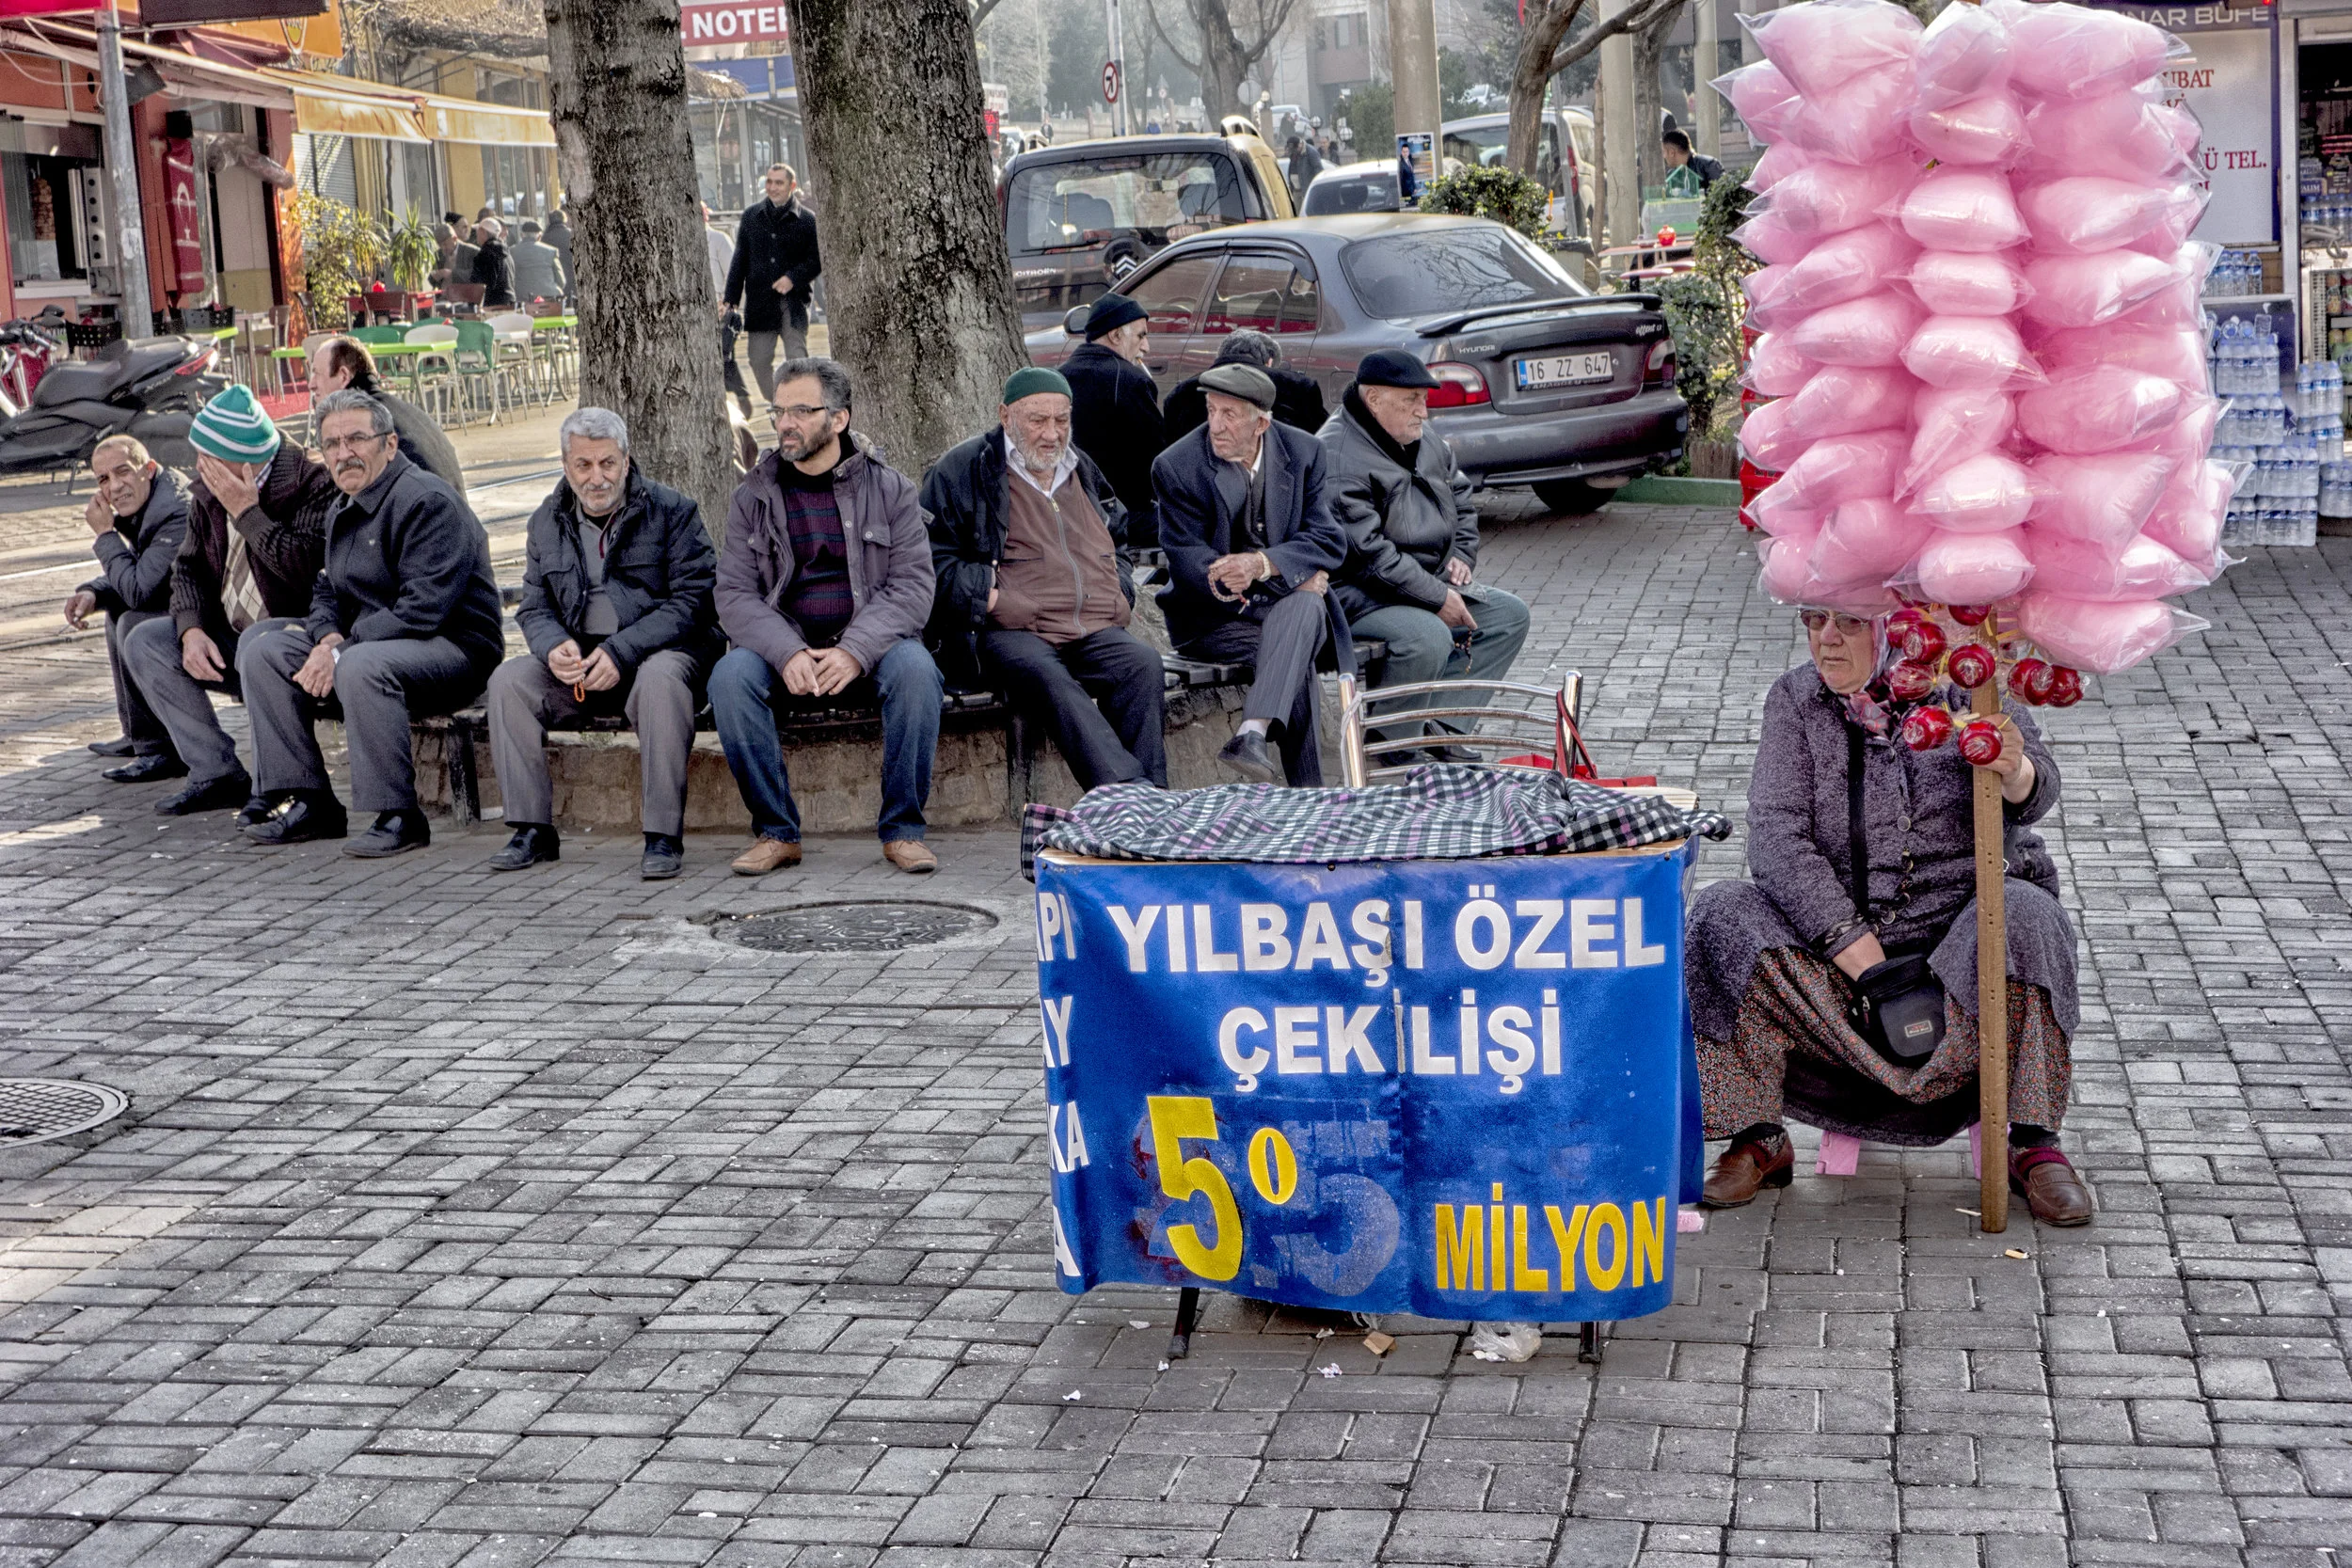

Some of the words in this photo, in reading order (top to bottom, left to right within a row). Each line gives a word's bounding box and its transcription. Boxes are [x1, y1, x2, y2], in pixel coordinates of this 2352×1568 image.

[2224, 150, 2267, 170] TEL.
[1459, 344, 1496, 355] HYUNDAI
[1529, 360, 1546, 382] 16
[1555, 358, 1574, 378] ZZ
[1583, 355, 1609, 375] 647
[1036, 892, 1076, 961] PI
[1108, 899, 1423, 988] YILBAŞI
[1454, 885, 1666, 971] ÖZEL
[1218, 989, 1562, 1094] ÇEKİLİŞİ
[1435, 1182, 1667, 1292] MİLYON
